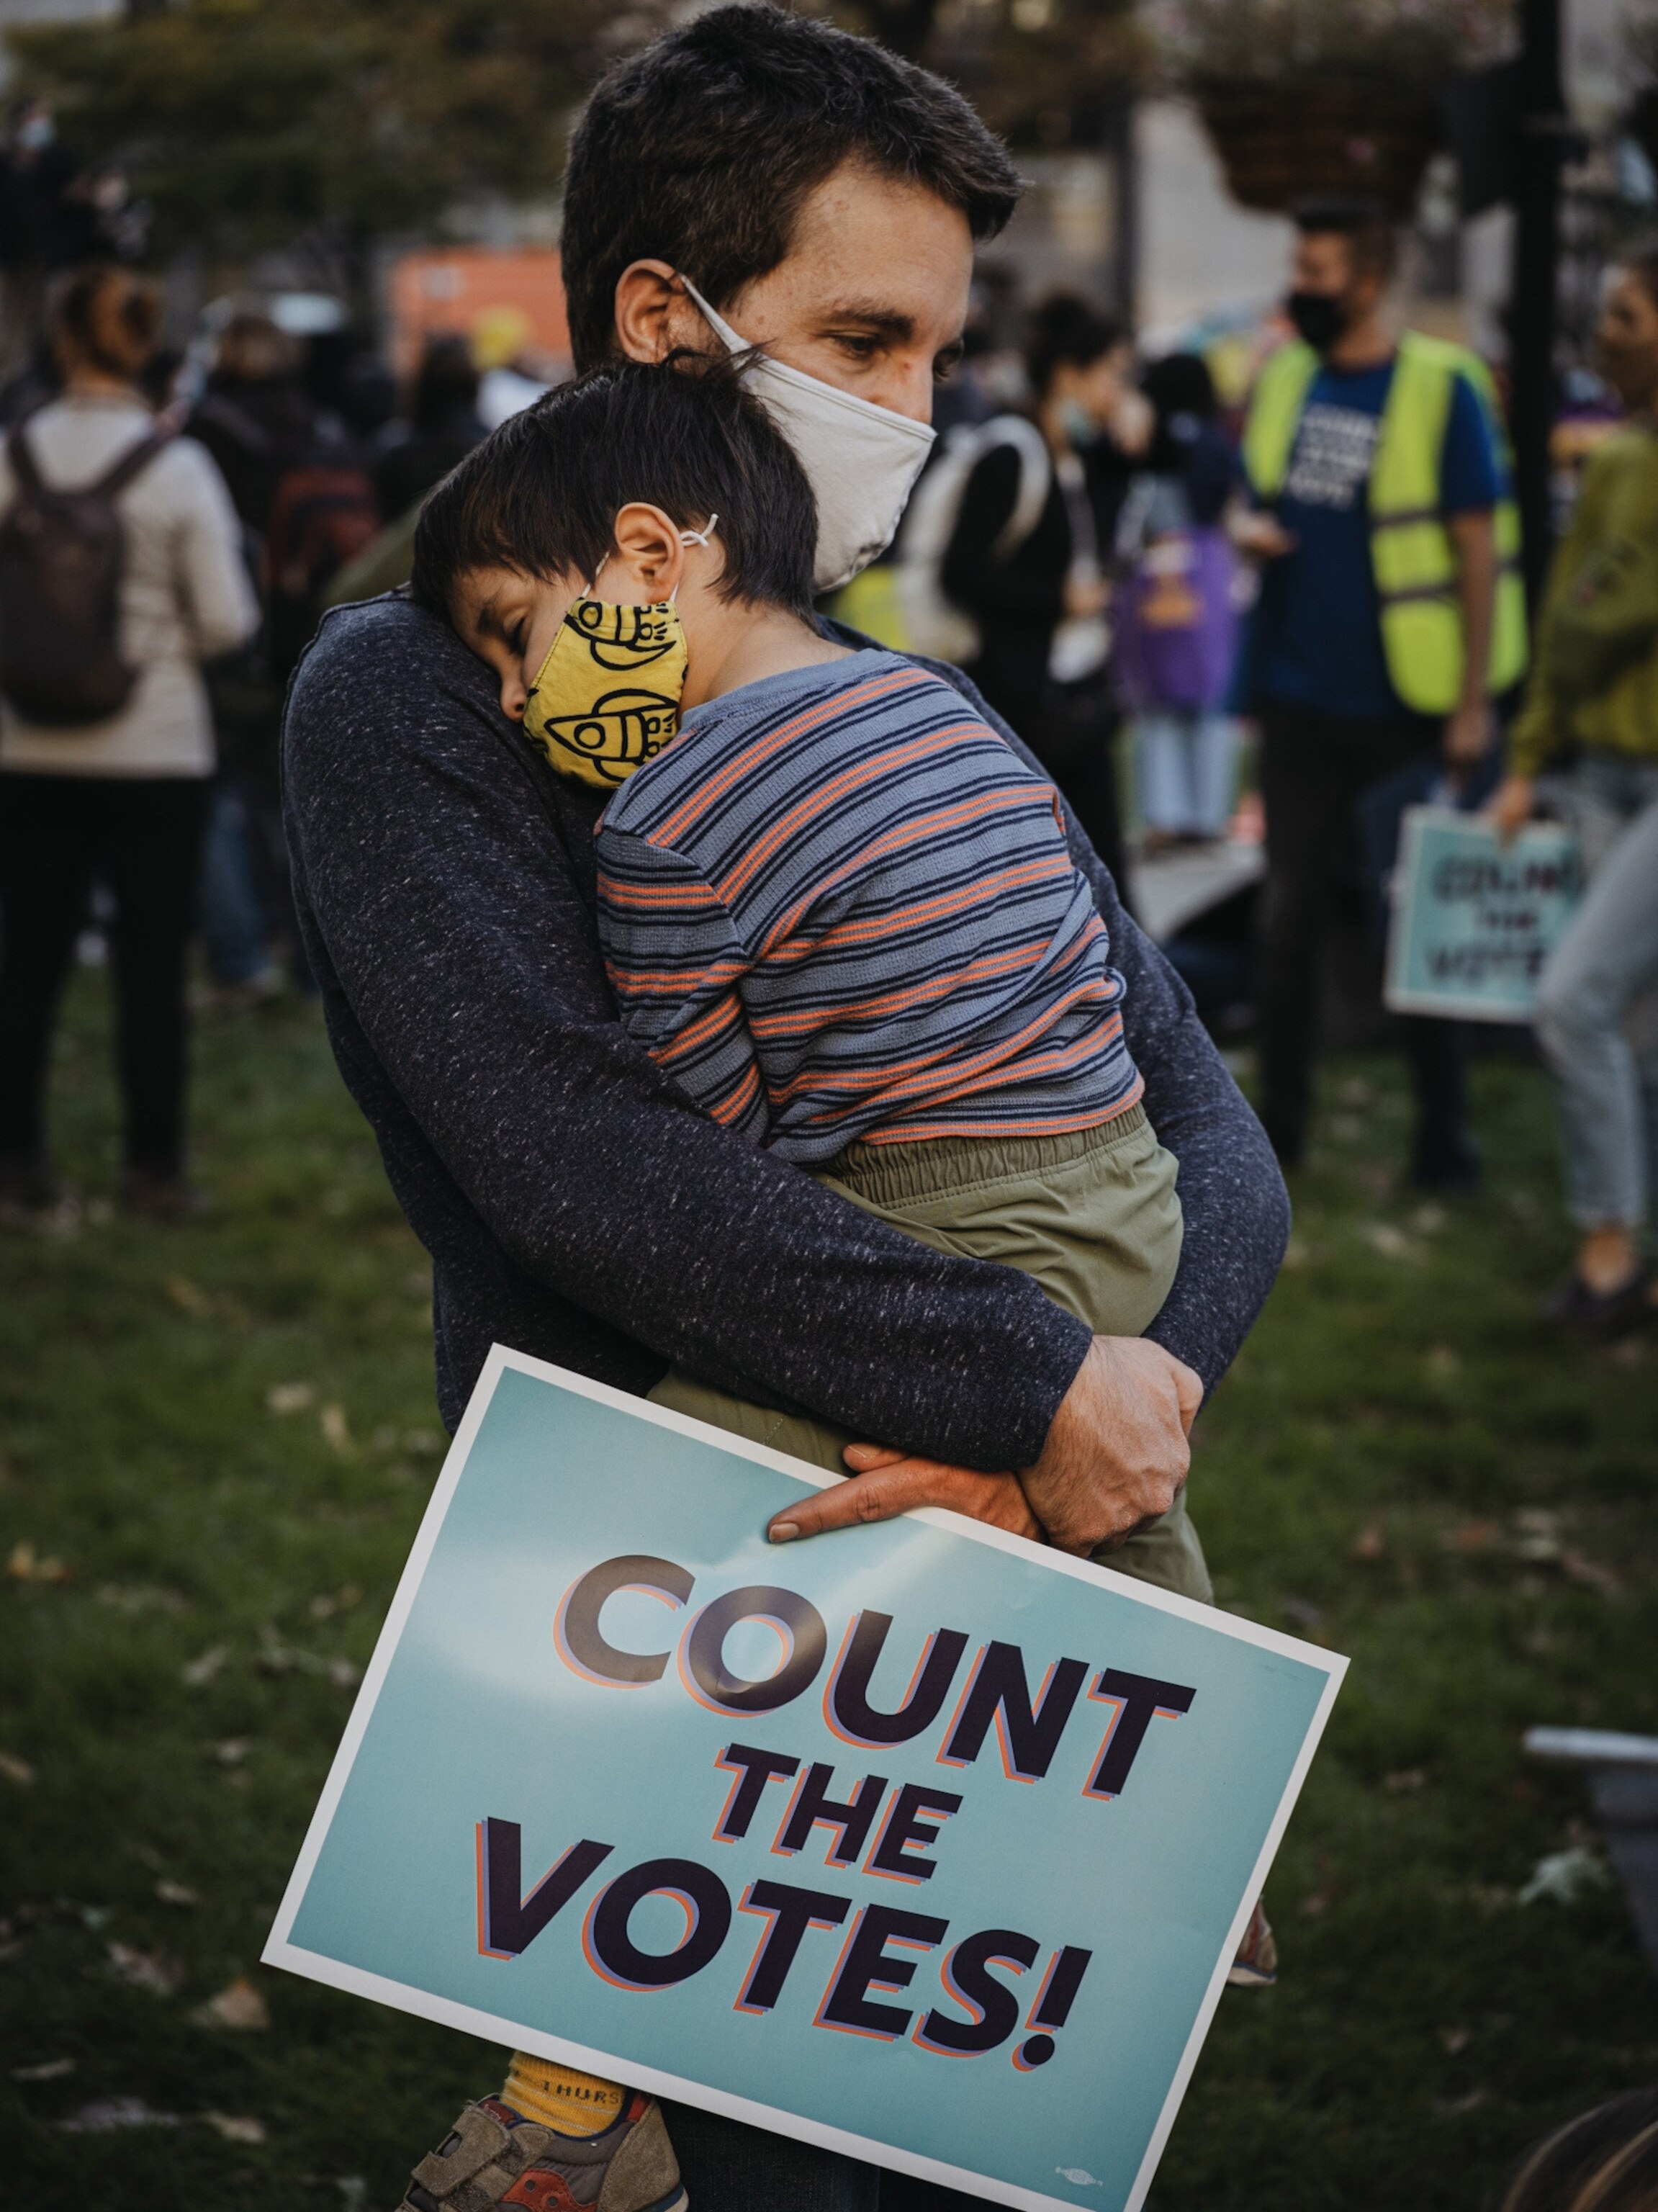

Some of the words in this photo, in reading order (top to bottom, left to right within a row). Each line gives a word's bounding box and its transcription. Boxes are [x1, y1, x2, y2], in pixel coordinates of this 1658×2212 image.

[553, 1555, 1197, 1801] COUNT
[712, 1743, 963, 1884] THE
[475, 1816, 1093, 2072] VOTES!
